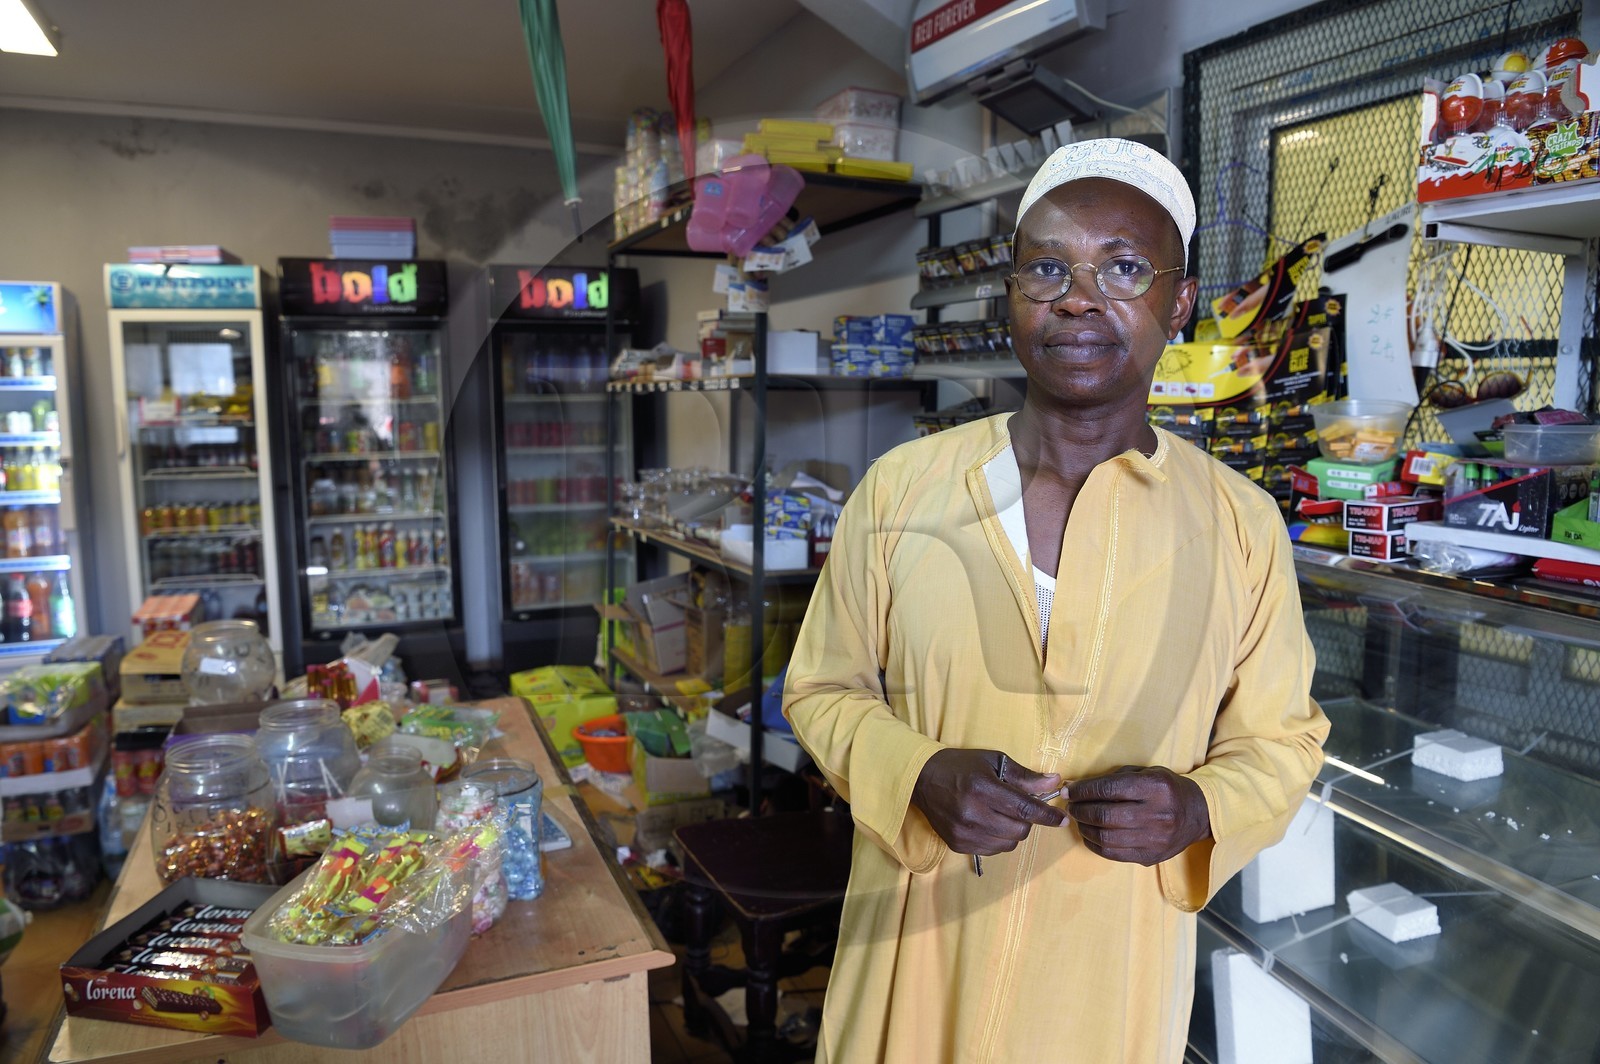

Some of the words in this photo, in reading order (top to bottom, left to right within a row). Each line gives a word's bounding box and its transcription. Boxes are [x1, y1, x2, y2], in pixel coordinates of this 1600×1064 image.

[914, 18, 933, 46] RED
[934, 0, 976, 35] FOREVER
[1546, 131, 1573, 147] CRAZY
[1550, 138, 1583, 153] FRIENDS
[137, 275, 249, 289] WESTPOINT
[309, 262, 418, 305] bold
[517, 269, 608, 310] bold
[1476, 500, 1521, 531] TAJ
[1518, 524, 1540, 533] Lighter
[195, 904, 253, 920] loren
[170, 918, 243, 933] lorena
[148, 932, 223, 948] lorena
[86, 979, 136, 1001] lorena
